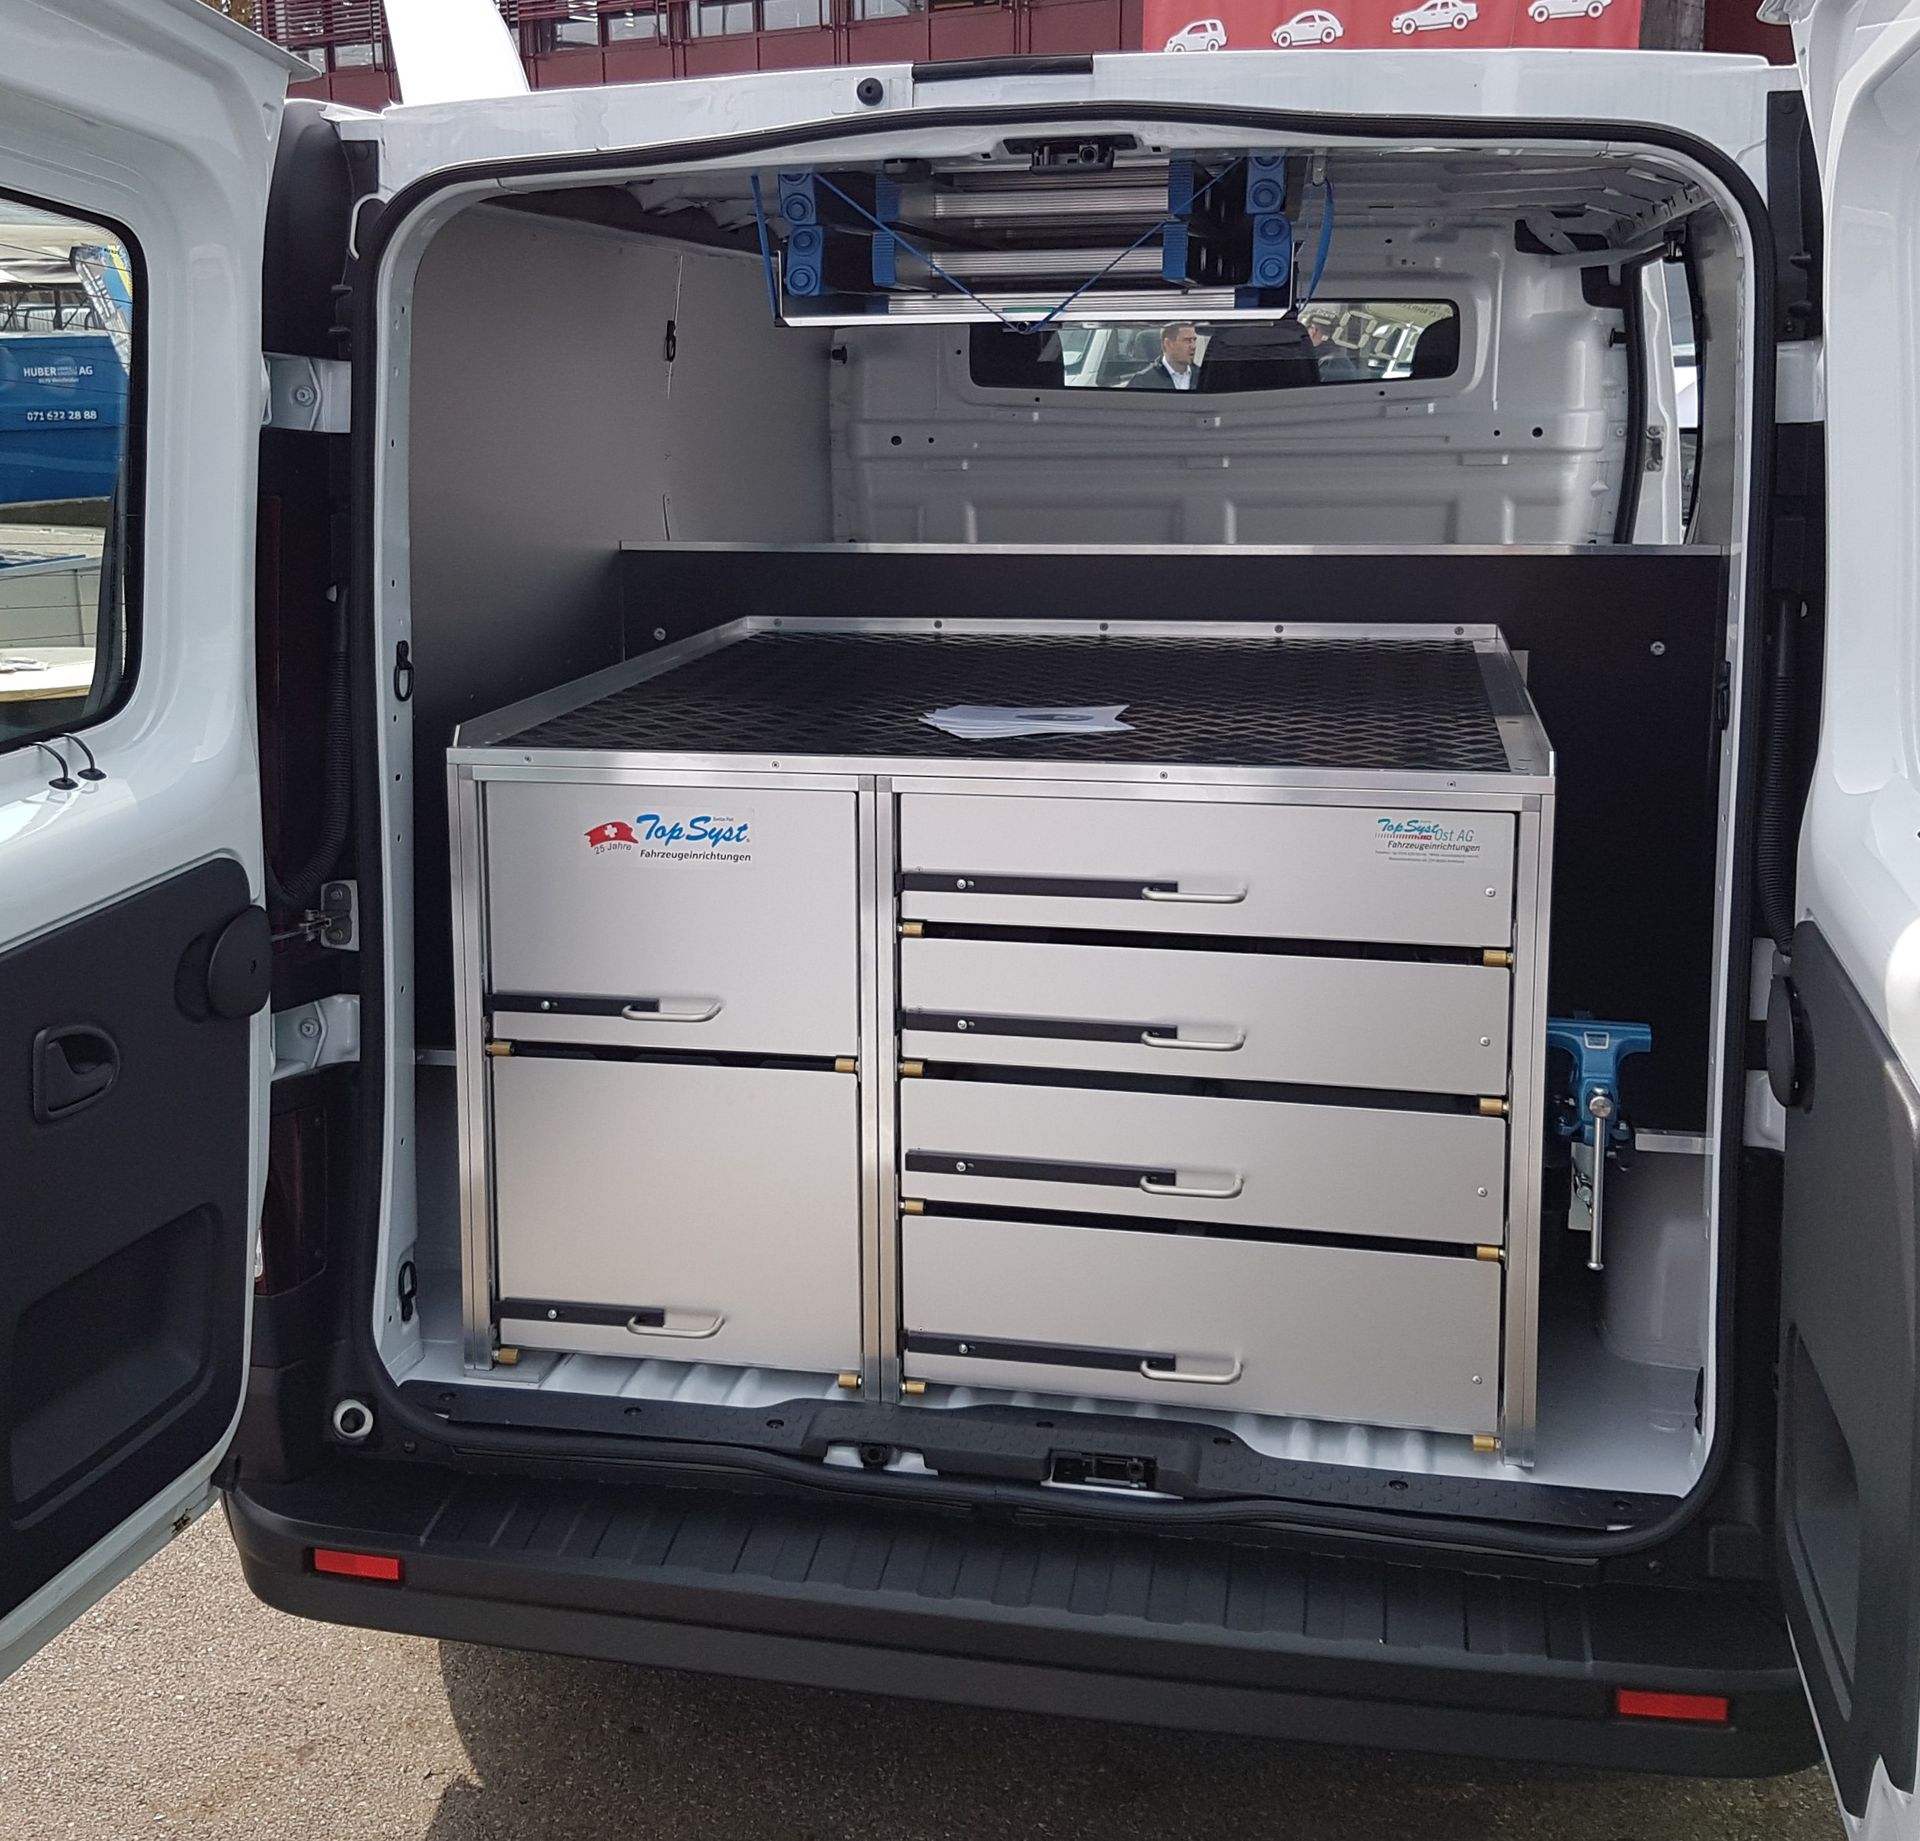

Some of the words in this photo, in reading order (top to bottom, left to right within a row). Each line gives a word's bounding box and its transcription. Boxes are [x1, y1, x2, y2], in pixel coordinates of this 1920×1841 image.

[23, 367, 57, 377] HUBER
[79, 366, 93, 375] AG
[27, 411, 44, 421] 071
[68, 410, 81, 420] 28
[84, 410, 97, 420] 88
[636, 813, 749, 847] TopSyst
[1434, 828, 1454, 841] Ost
[1456, 828, 1475, 842] AG
[593, 846, 605, 854] 25
[607, 842, 632, 851] Jahre
[1387, 840, 1480, 852] Fahrzeugeinrichtungen
[639, 849, 751, 863] Fahrzeugeinrichtungen
